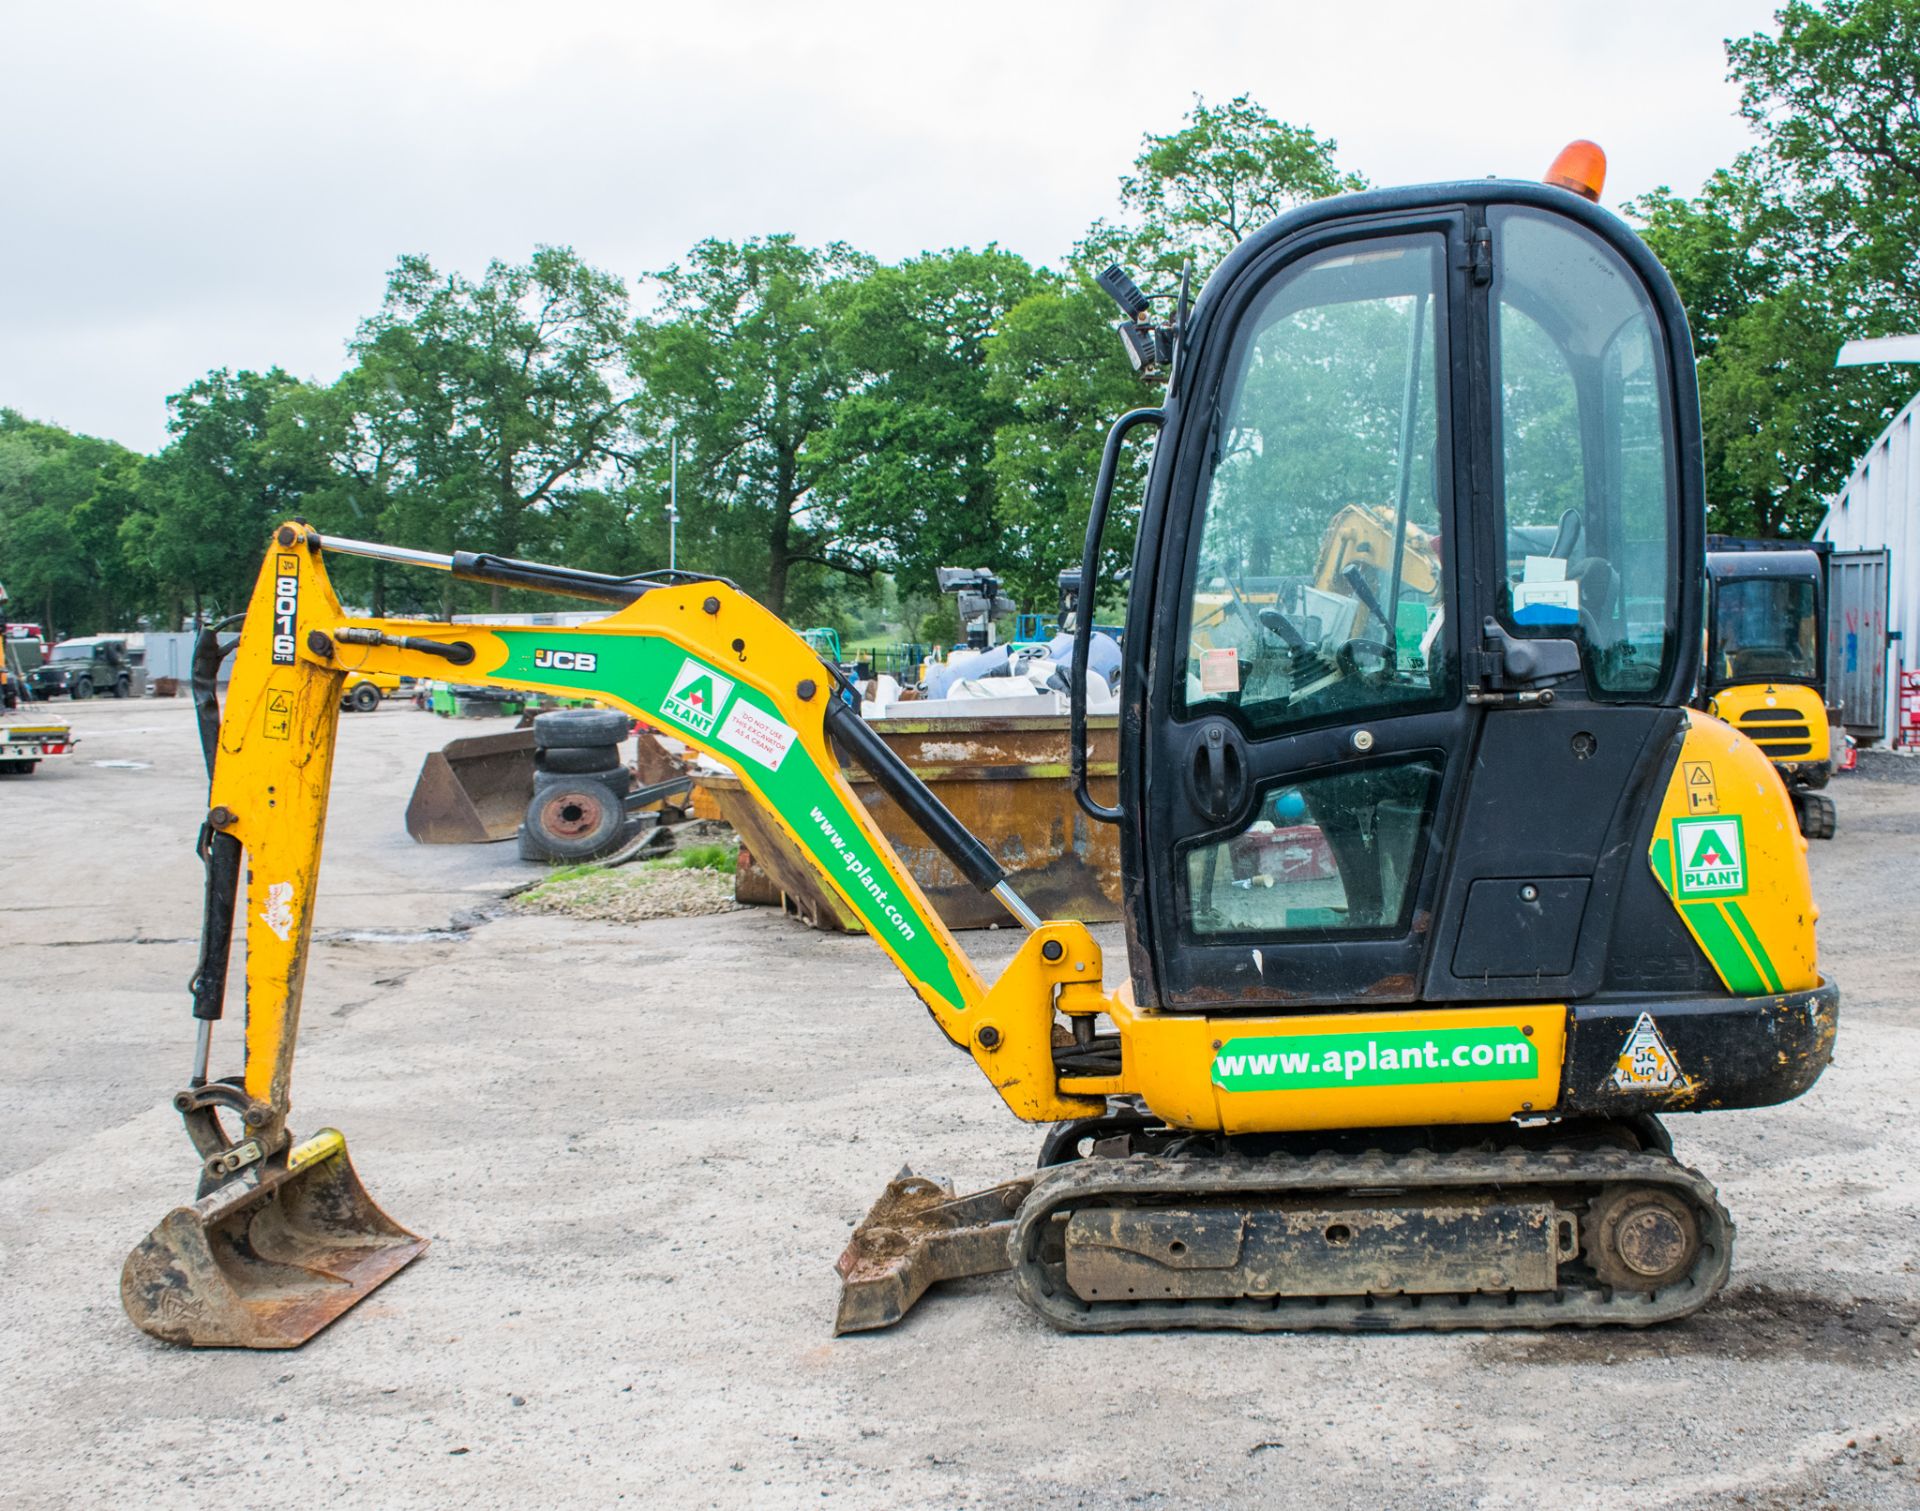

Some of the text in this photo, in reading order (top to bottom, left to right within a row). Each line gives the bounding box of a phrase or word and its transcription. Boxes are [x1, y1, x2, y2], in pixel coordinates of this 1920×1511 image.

[274, 577, 297, 654] 8016
[535, 650, 596, 672] JCB
[676, 674, 713, 716] A
[663, 699, 712, 732] PLANT
[742, 713, 783, 739] DO NOT USE
[733, 716, 786, 751] THIS EXCAVATOR
[735, 728, 744, 736] AS
[752, 738, 773, 752] CRANE
[1689, 829, 1735, 867] A
[809, 806, 916, 941] www.aplant.com
[1685, 871, 1739, 886] PLANT
[1216, 1041, 1529, 1081] www.aplant.com
